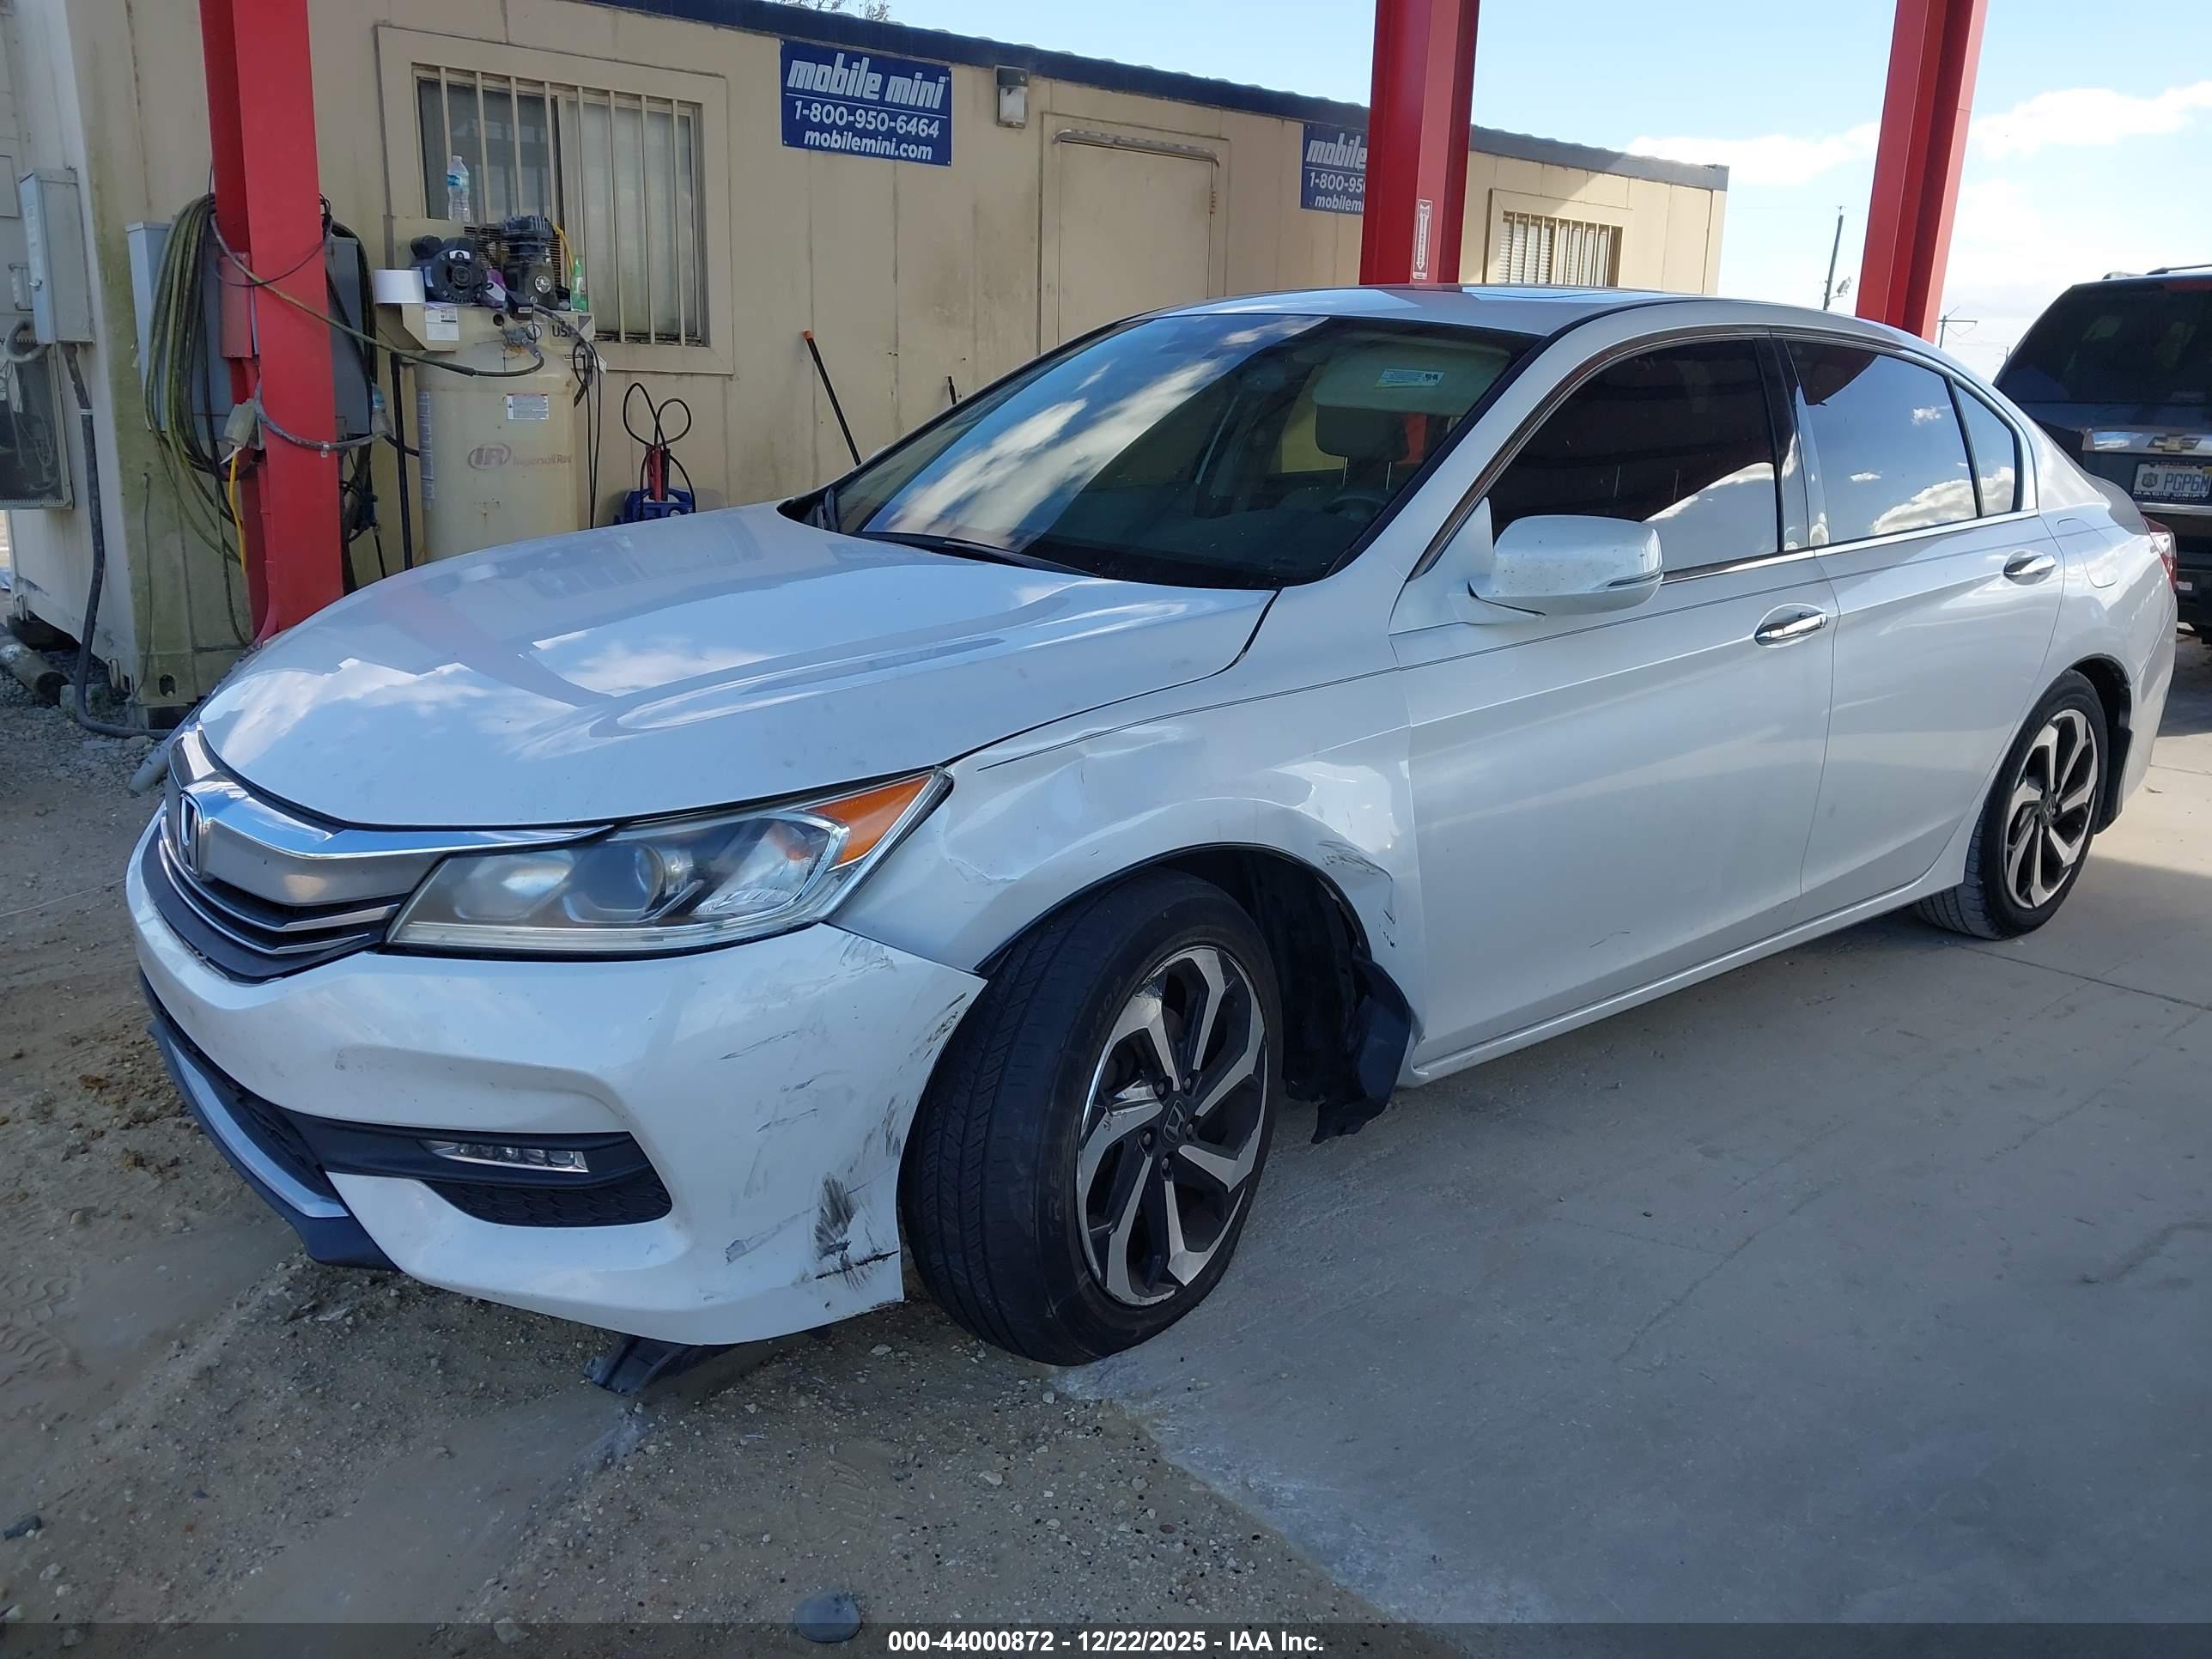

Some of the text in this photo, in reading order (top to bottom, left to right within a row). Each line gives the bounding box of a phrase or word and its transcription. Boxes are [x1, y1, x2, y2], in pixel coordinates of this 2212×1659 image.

[787, 52, 946, 109] mobile mini
[794, 100, 939, 138] 1-800-950-6464
[804, 130, 933, 160] mobilemini.com
[551, 325, 573, 337] US
